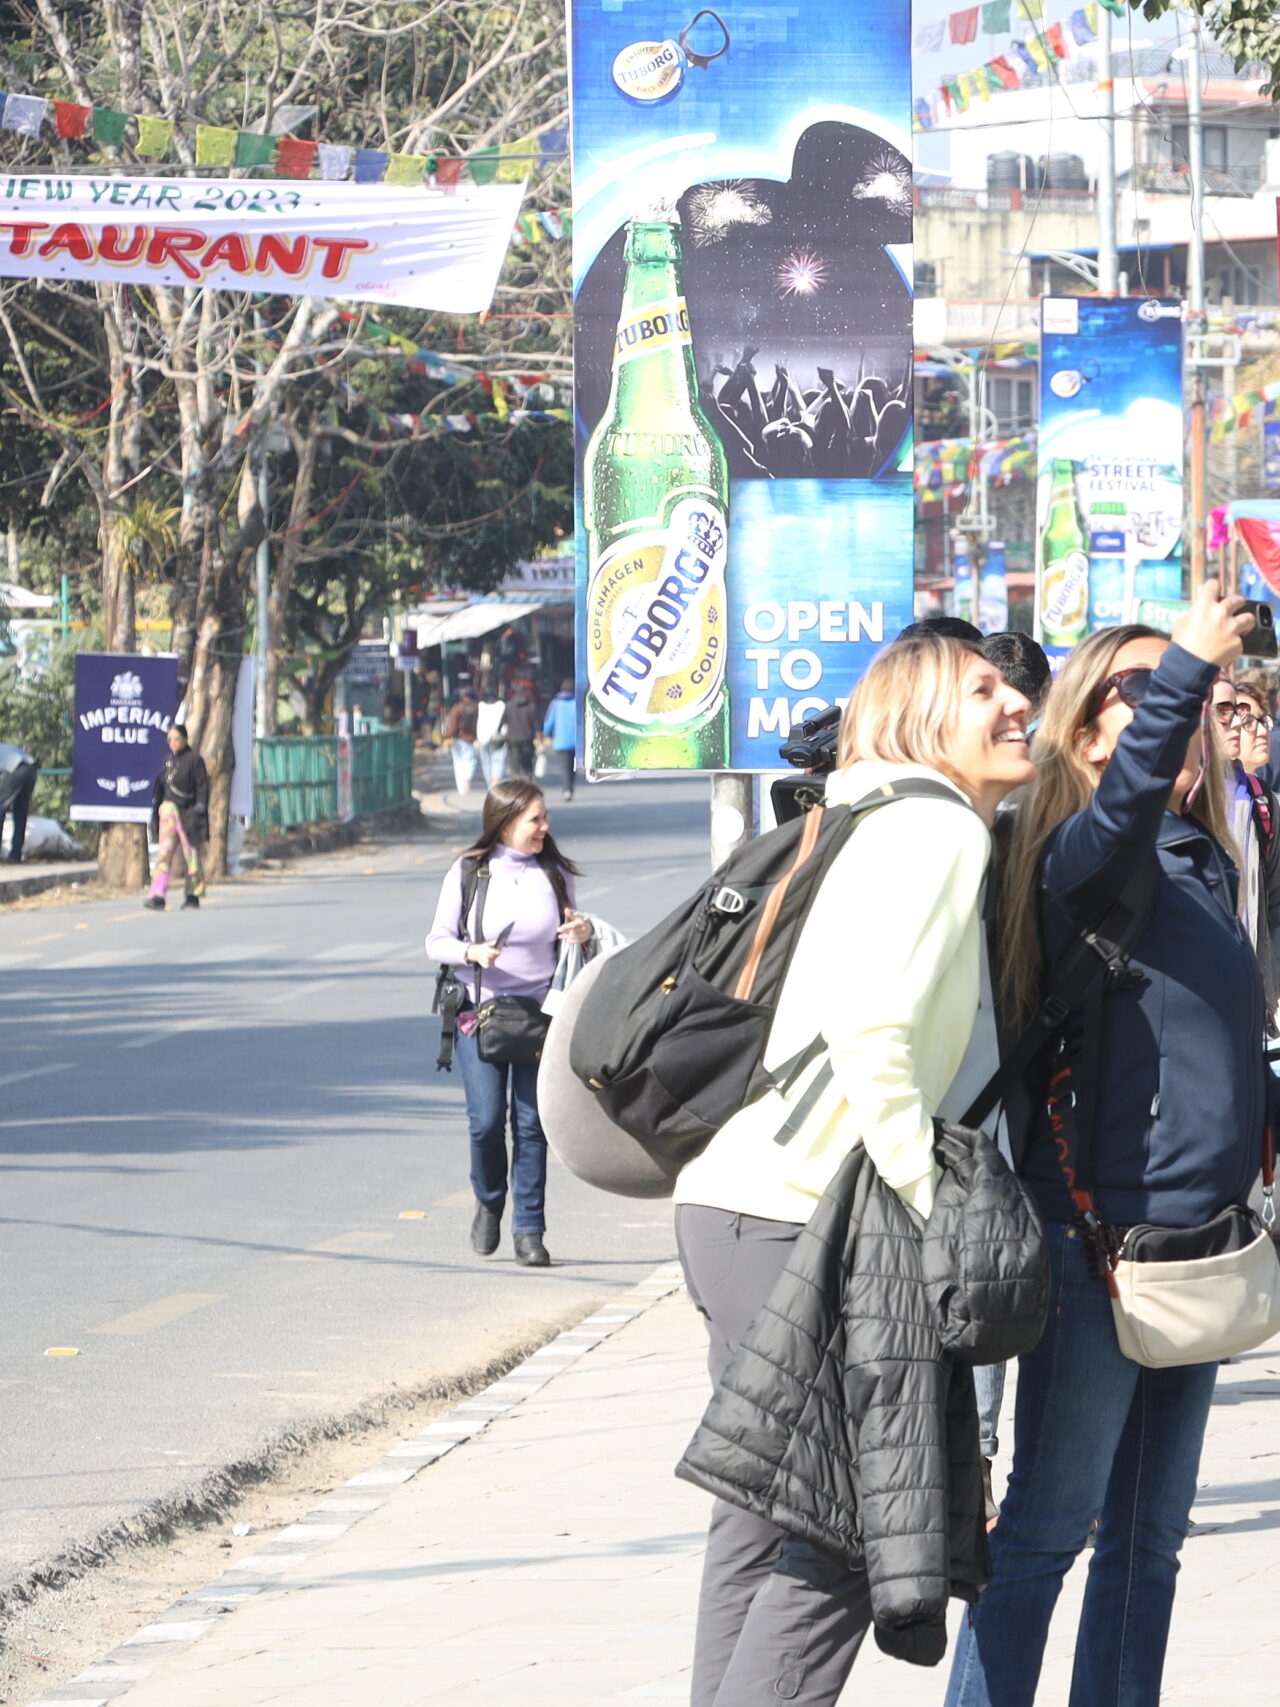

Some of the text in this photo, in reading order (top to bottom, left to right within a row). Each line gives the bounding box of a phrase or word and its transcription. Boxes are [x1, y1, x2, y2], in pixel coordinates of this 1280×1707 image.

[90, 180, 183, 212] YEAR
[615, 307, 689, 353] TUBORG
[1089, 479, 1158, 491] FESTIVAL
[1090, 464, 1158, 478] STREET
[593, 557, 644, 651] COPENHAGEN
[743, 602, 884, 643] OPEN
[602, 548, 710, 706] TUBORG
[690, 636, 719, 685] GOLD
[745, 649, 823, 690] TO
[80, 707, 171, 732] IMPERIAL
[101, 727, 149, 744] BLUE
